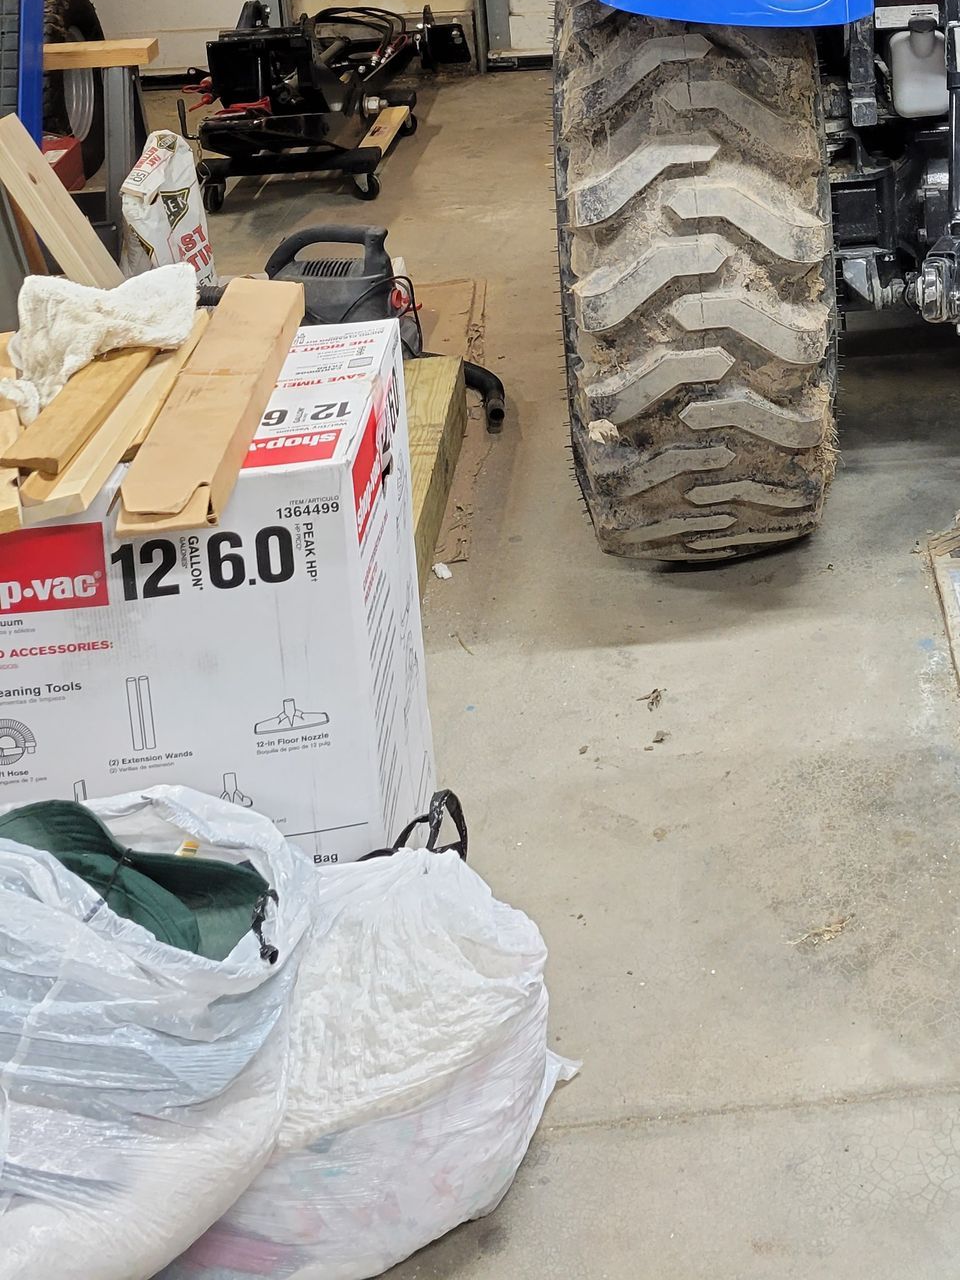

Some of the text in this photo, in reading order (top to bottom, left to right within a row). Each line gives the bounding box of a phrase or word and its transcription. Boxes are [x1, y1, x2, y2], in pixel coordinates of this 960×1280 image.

[303, 343, 345, 353] RIGHT
[349, 338, 376, 347] THE
[283, 372, 368, 389] SAVE TIME!
[261, 408, 289, 428] 6
[310, 401, 352, 422] 12
[276, 501, 340, 520] 1364499
[302, 521, 316, 558] PEAK
[207, 525, 295, 590] 6.0
[111, 538, 180, 602] 12
[9, 640, 114, 658] ACCESSORIES:
[45, 681, 82, 694] Tools
[278, 737, 299, 746] Floor
[301, 732, 329, 742] Nozzle
[109, 750, 193, 767] (2) Extension Wands
[313, 852, 338, 865] Bag
